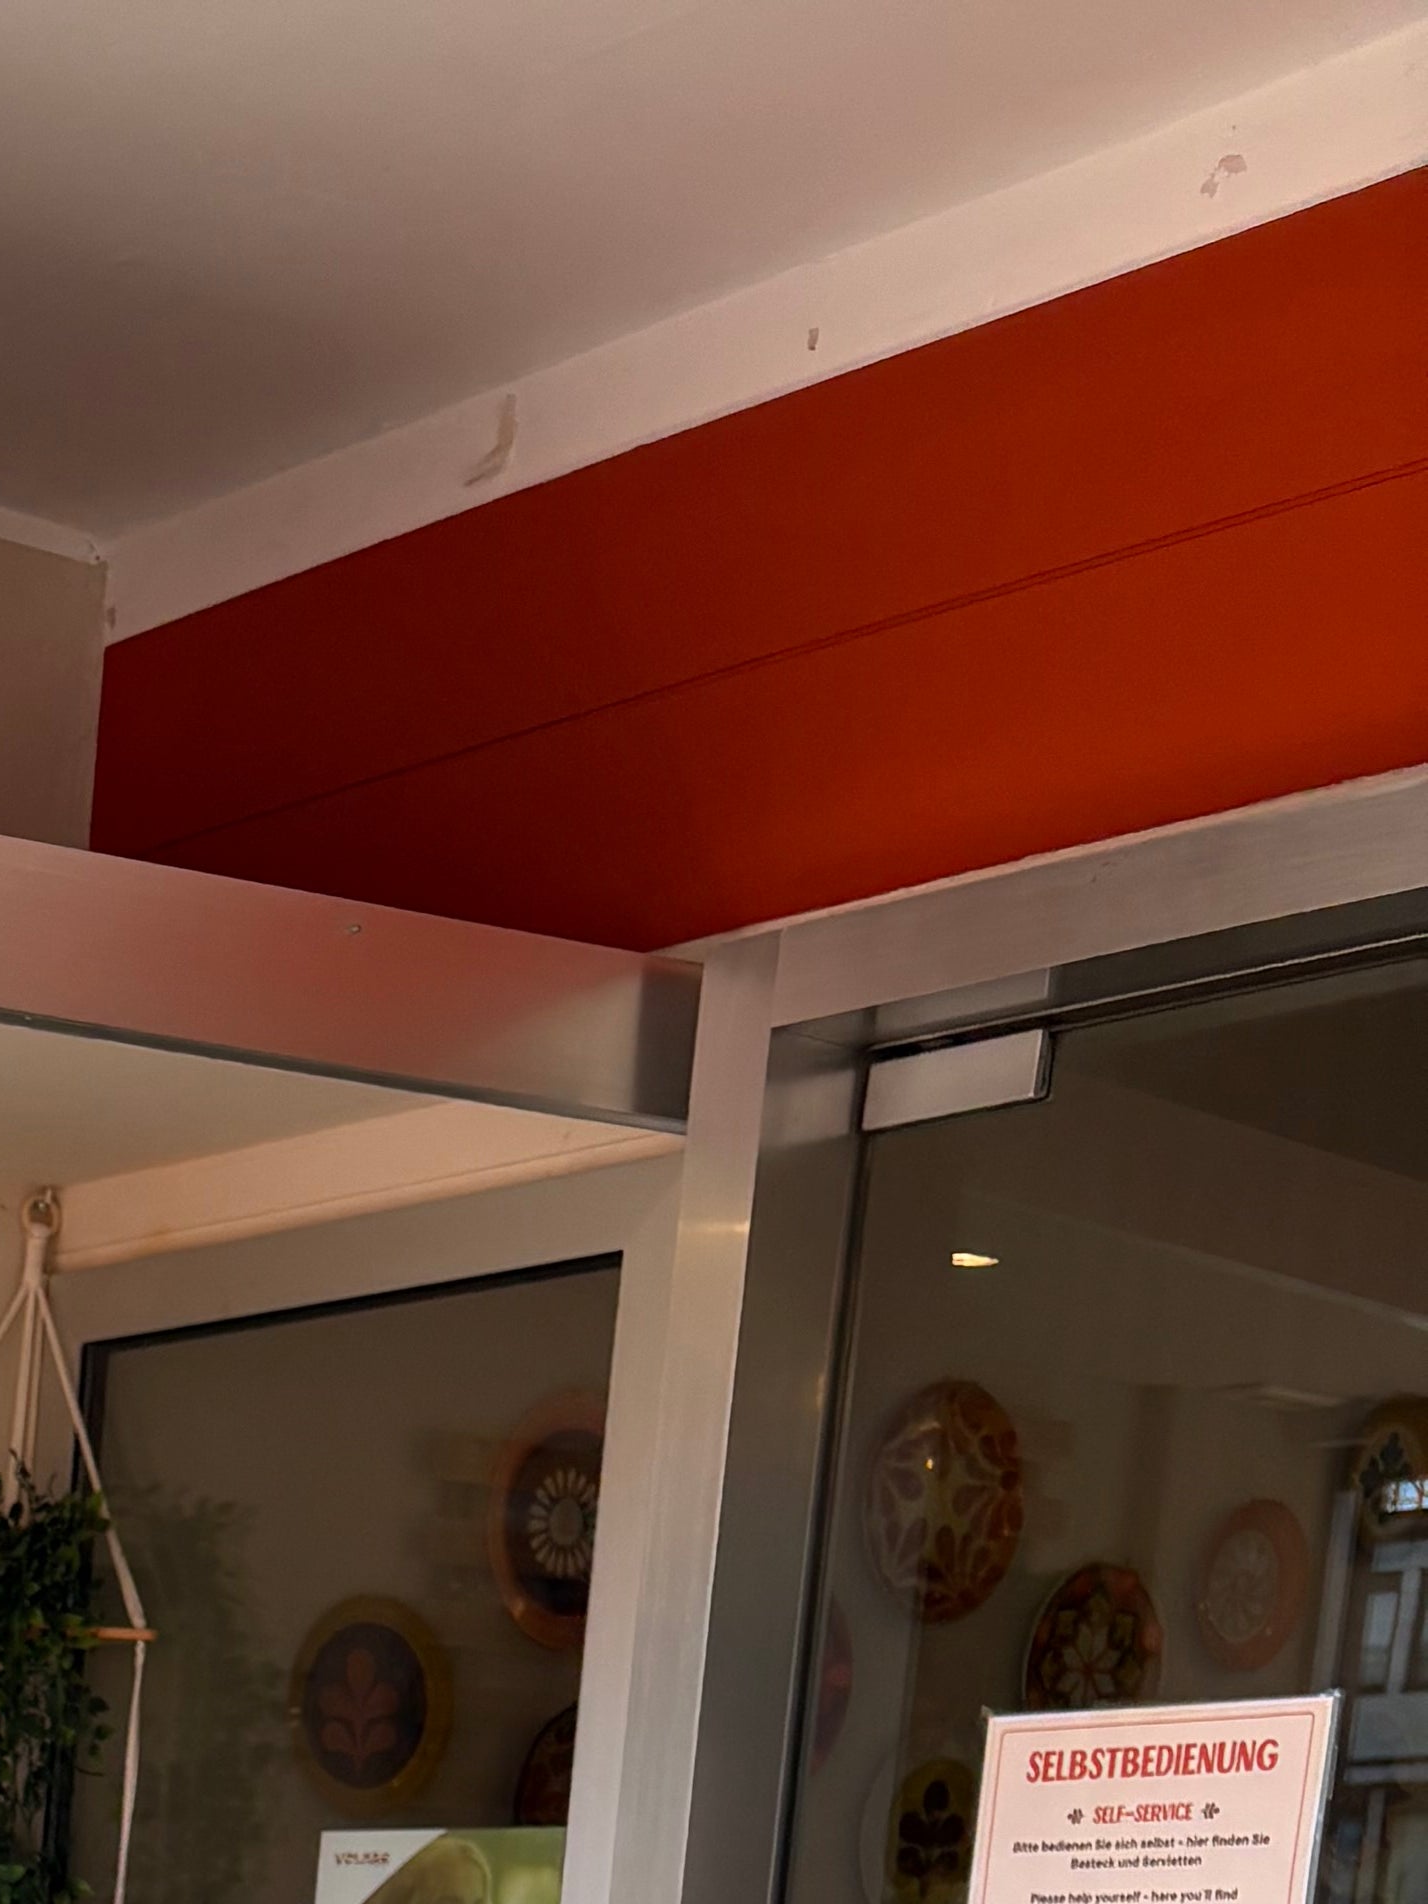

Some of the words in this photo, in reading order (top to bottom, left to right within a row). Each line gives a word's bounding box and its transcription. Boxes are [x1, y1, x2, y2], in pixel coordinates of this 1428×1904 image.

[1025, 1738, 1279, 1784] SELBSTBEDIENUNG
[1092, 1802, 1194, 1825] SELF-SERVICE
[1012, 1842, 1039, 1853] Bitte
[1041, 1839, 1093, 1852] bedienen
[1095, 1839, 1112, 1851] Sie
[1115, 1837, 1137, 1850] sich
[1140, 1836, 1175, 1849] selbst
[1186, 1836, 1208, 1848] hier
[1212, 1835, 1249, 1847] finden
[1252, 1834, 1270, 1846] Sie
[1070, 1857, 1115, 1870] Besteck
[1118, 1857, 1139, 1868] und
[1142, 1855, 1202, 1868] Servietten
[1030, 1893, 1066, 1904] Please
[1095, 1891, 1141, 1904] yourself
[1151, 1890, 1177, 1902] here
[1215, 1888, 1238, 1901] find
